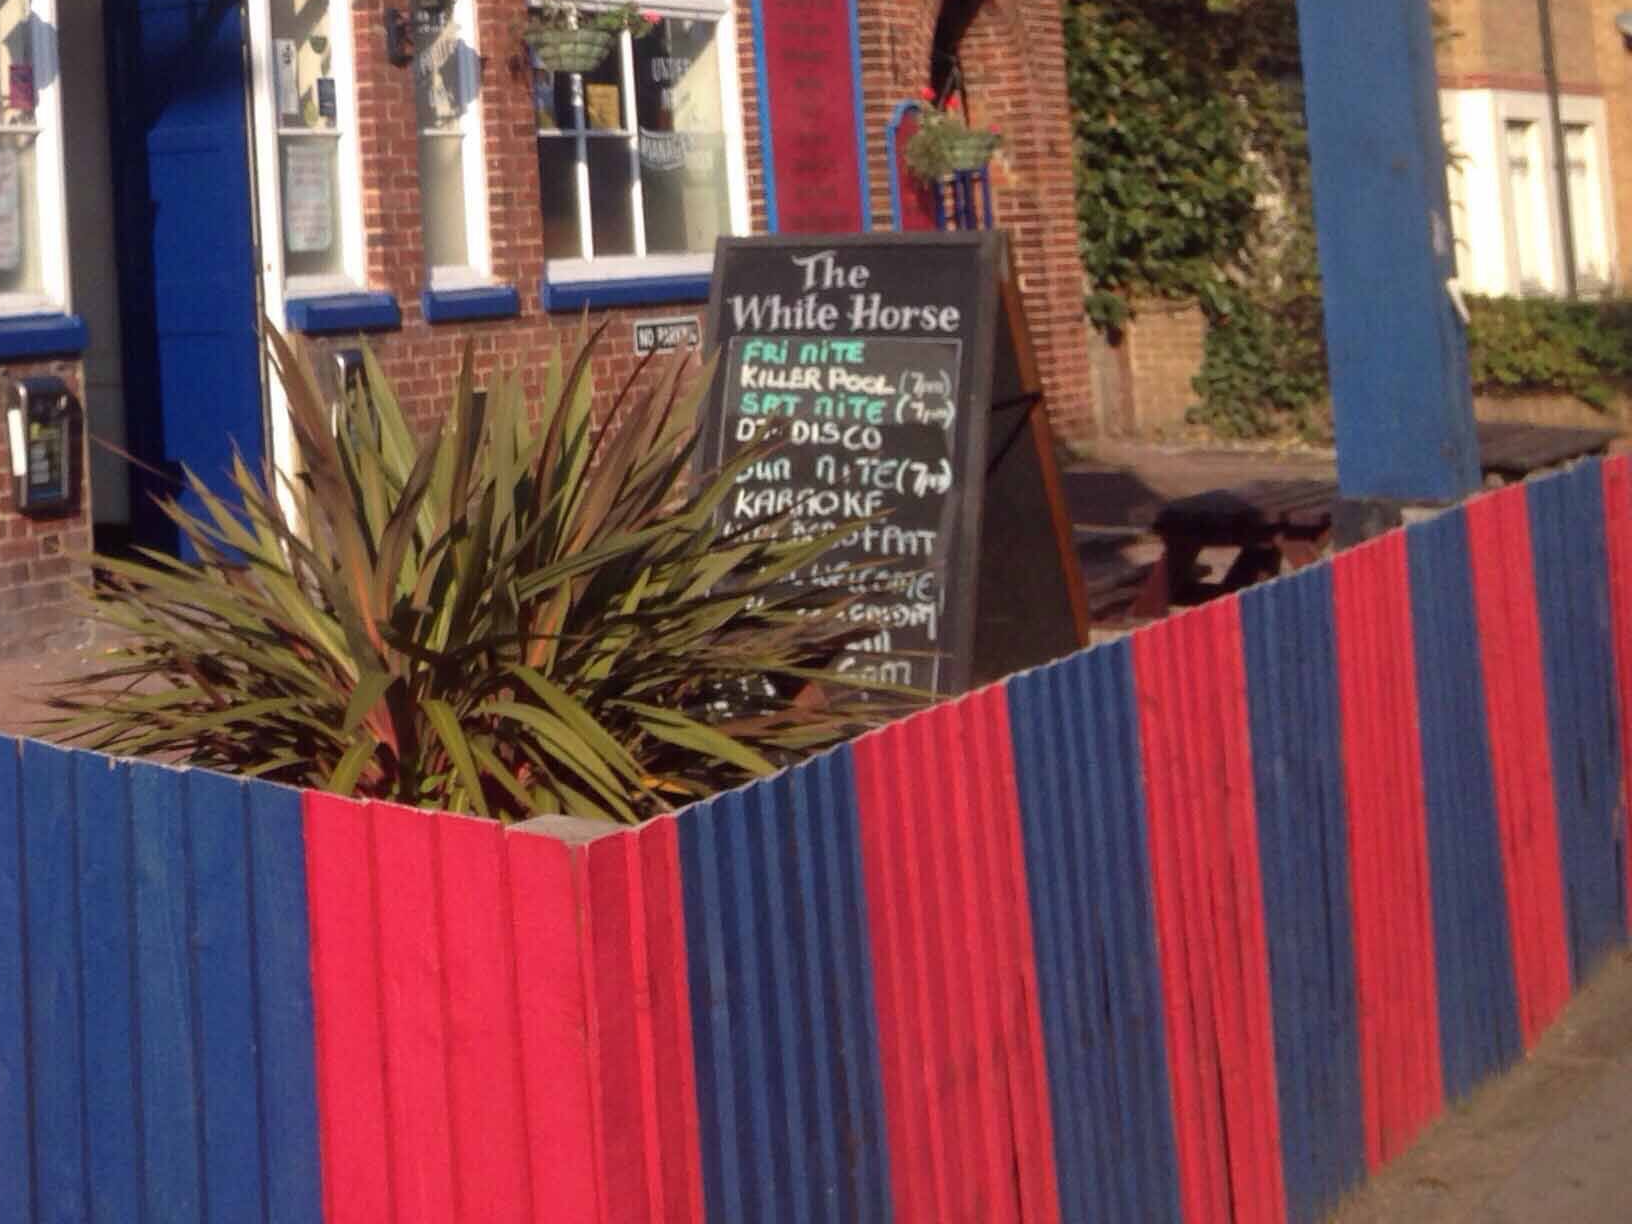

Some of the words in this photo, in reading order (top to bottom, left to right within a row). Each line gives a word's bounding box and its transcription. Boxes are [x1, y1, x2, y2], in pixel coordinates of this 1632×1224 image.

[791, 249, 870, 291] The
[726, 293, 839, 331] White
[846, 292, 961, 332] Horse
[792, 420, 883, 451] DISCO
